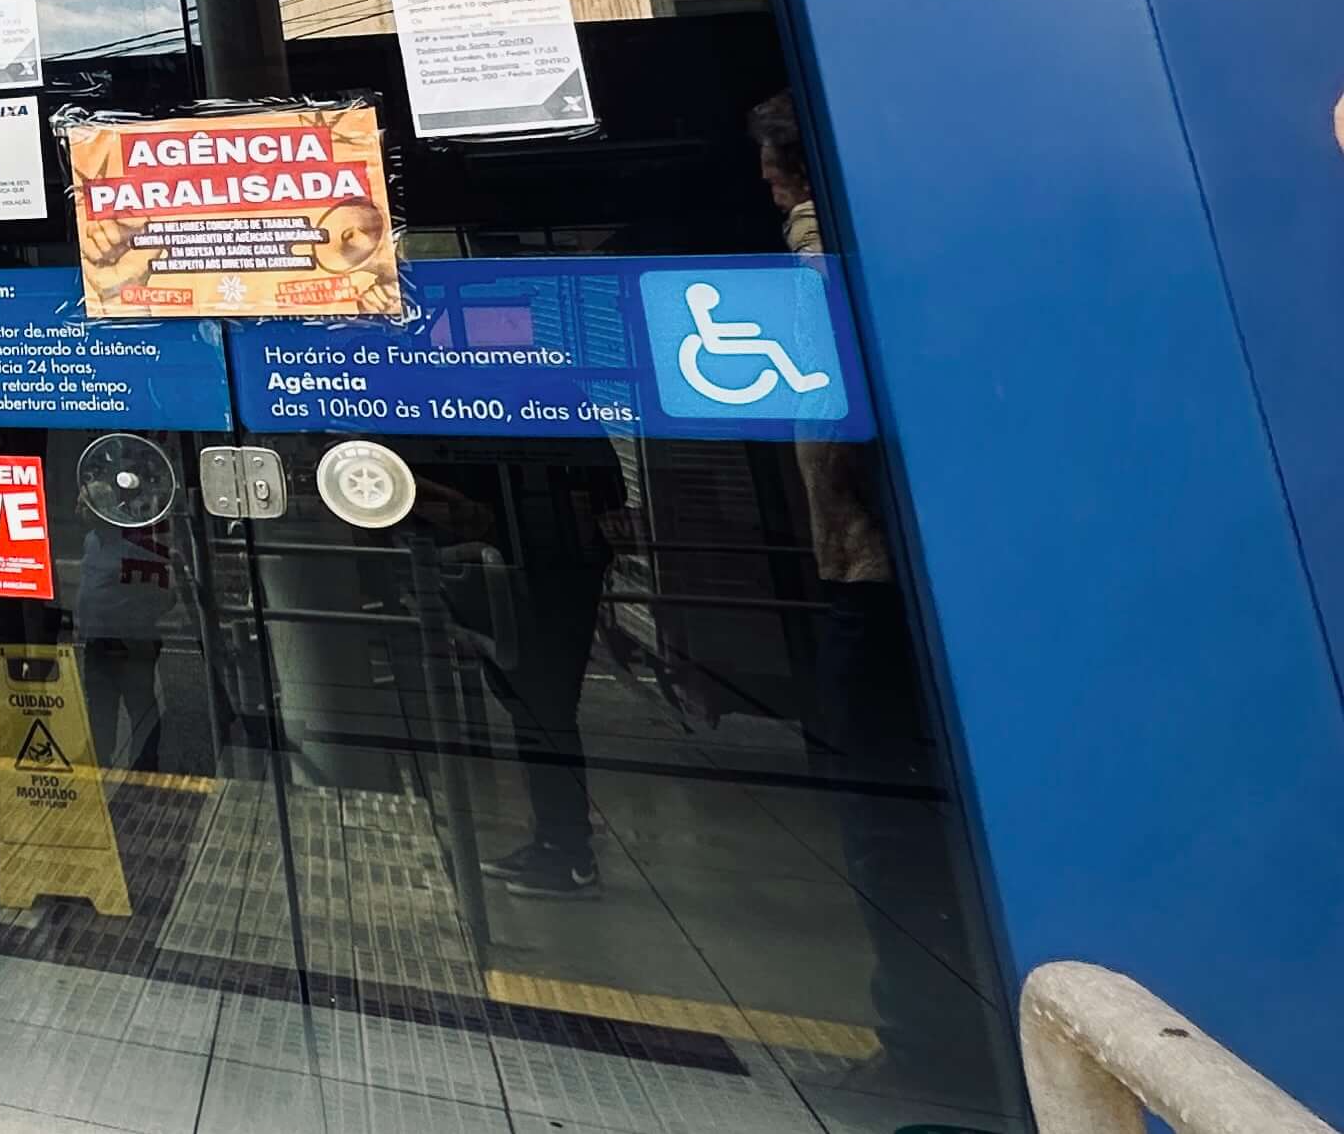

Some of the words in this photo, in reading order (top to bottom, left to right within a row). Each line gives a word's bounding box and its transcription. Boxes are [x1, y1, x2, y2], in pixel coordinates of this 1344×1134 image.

[128, 132, 327, 168] AGÊNCIA
[90, 169, 366, 213] PARALISADA
[46, 322, 89, 342] metal;
[76, 341, 86, 356] à
[90, 339, 160, 361] distância;
[265, 346, 345, 364] Horário
[353, 346, 380, 364] de
[388, 346, 572, 365] Funcionamento:
[27, 360, 47, 374] 24
[51, 359, 96, 379] horas;
[3, 377, 55, 392] retardo
[59, 376, 77, 392] de
[82, 379, 132, 396] tempo,
[268, 372, 367, 394] Agência
[61, 396, 129, 411] imediata.
[272, 398, 309, 416] das
[318, 398, 387, 417] 10h00
[395, 399, 421, 418] às
[429, 399, 512, 422] 16h00,
[520, 400, 570, 420] dias
[577, 402, 640, 421] úteis.
[9, 694, 64, 709] CUIDADO
[32, 775, 59, 787] PISO
[16, 786, 77, 801] MOLHADO
